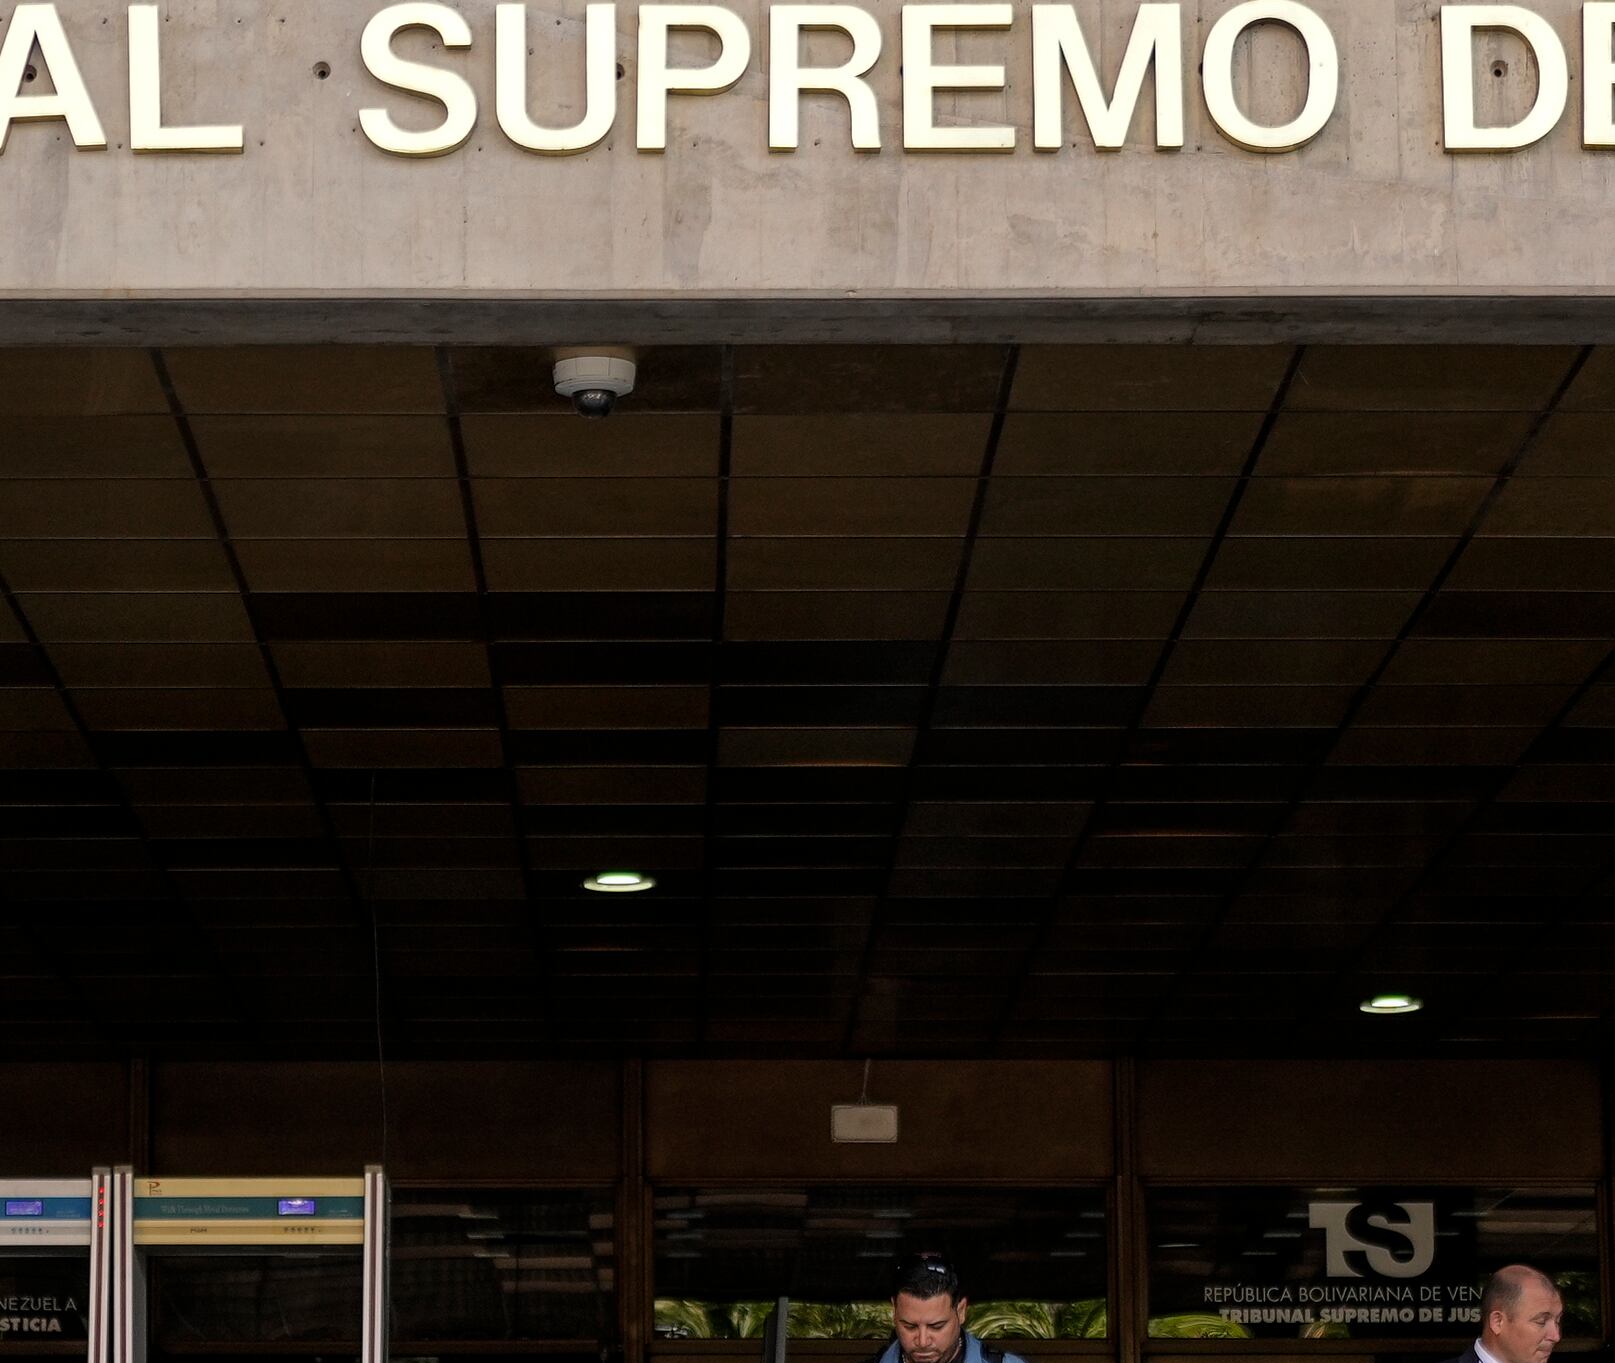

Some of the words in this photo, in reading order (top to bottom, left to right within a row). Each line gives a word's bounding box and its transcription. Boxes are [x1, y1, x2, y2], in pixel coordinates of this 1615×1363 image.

[358, 1, 1341, 158] SUPREMO
[1203, 1283, 1293, 1302] REPÚBLICA
[1298, 1287, 1414, 1302] BOLIVARIANA
[1419, 1287, 1441, 1301] DE
[1218, 1308, 1315, 1324] TRIBUNAL
[1319, 1307, 1415, 1323] SUPREMO
[1418, 1308, 1444, 1323] DE
